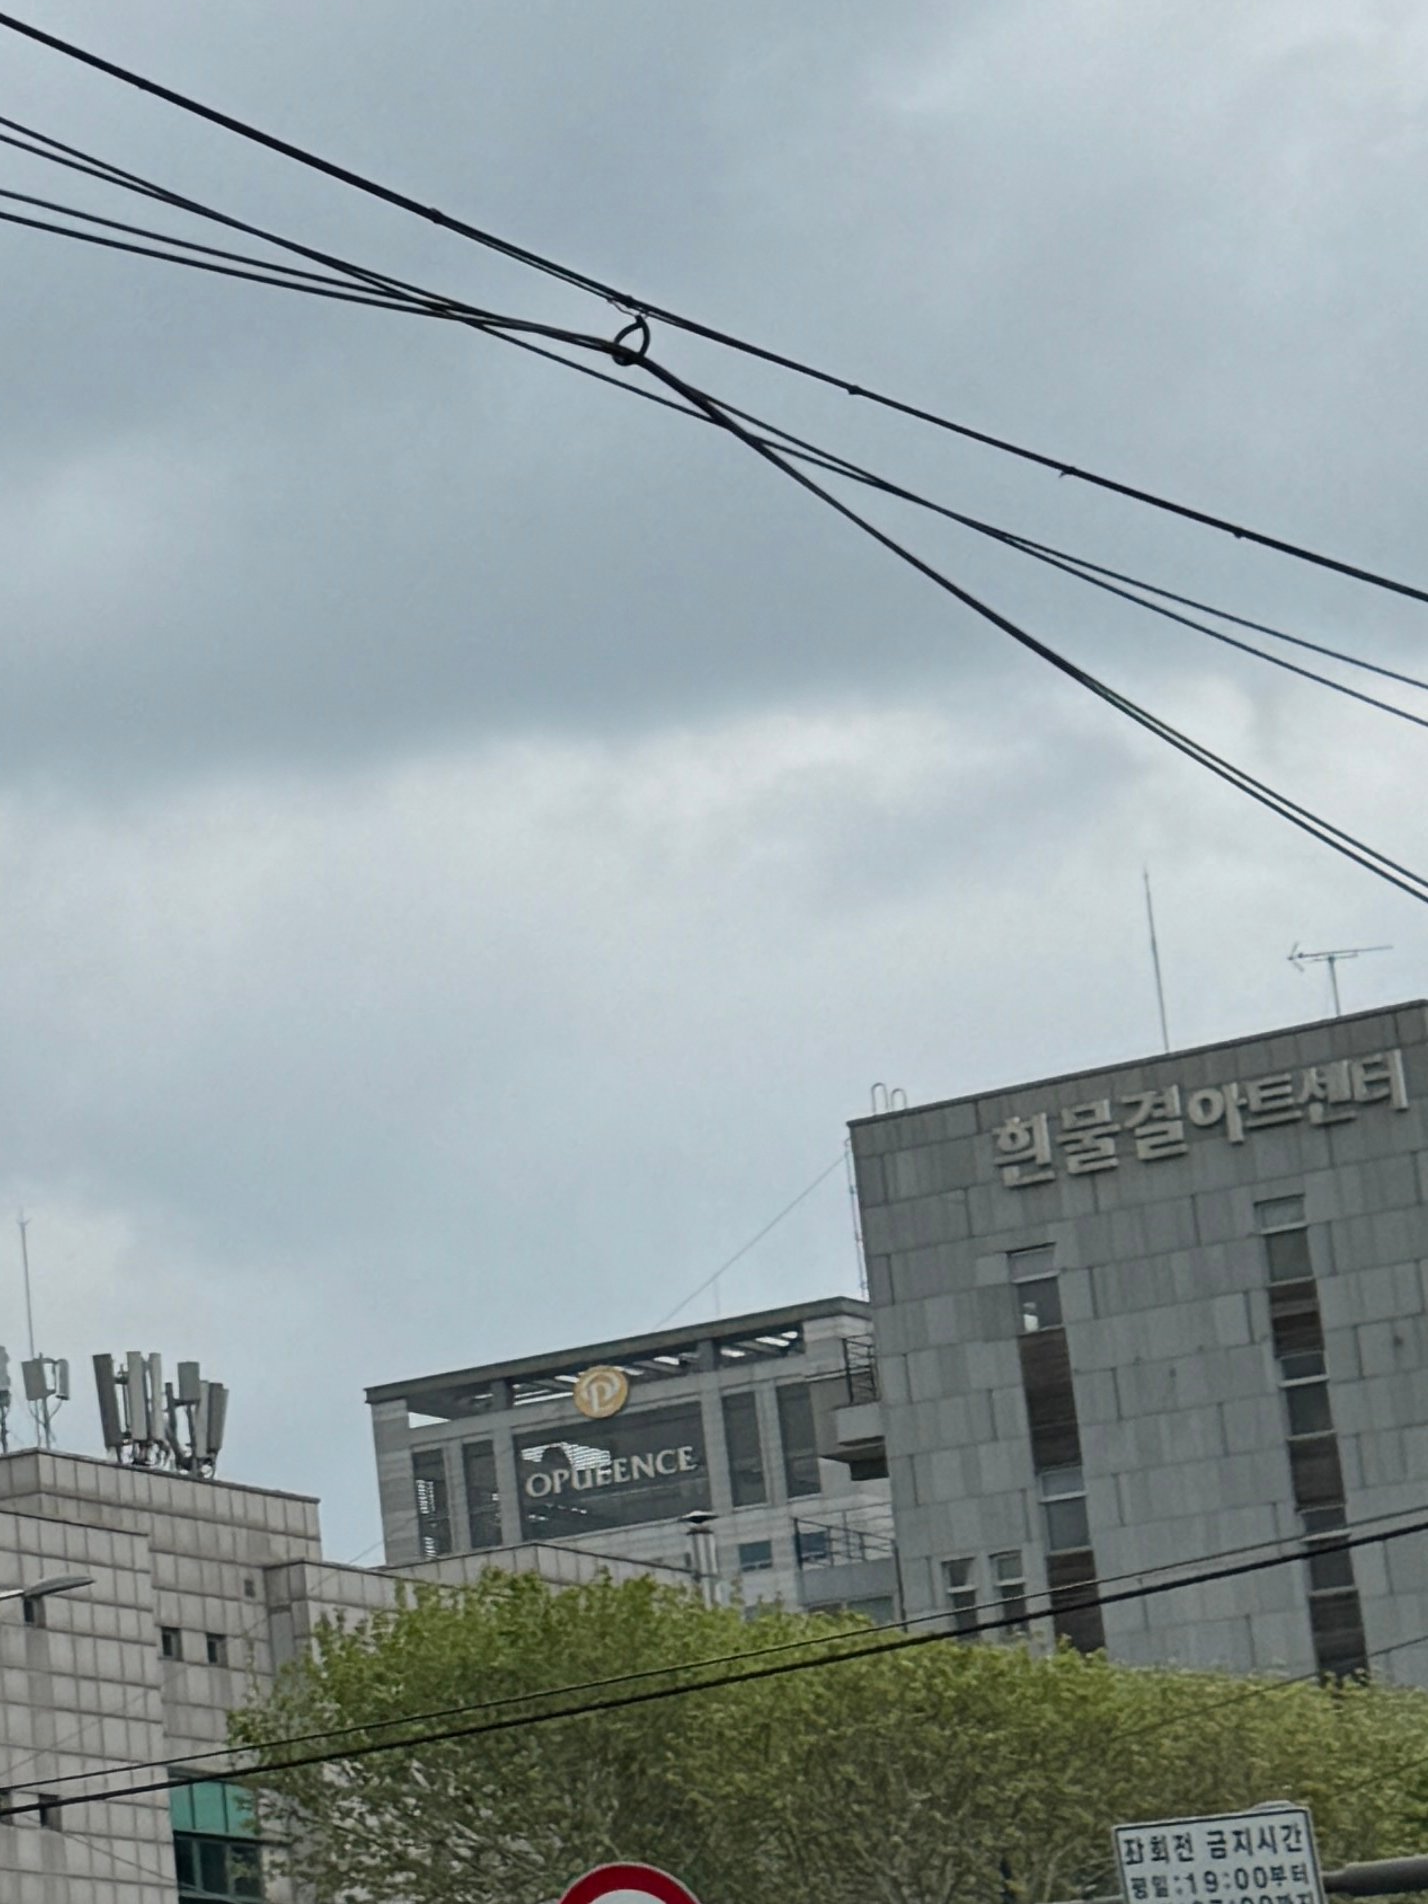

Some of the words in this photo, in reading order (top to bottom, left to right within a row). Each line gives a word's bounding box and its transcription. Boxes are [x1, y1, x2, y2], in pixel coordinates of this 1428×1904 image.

[992, 1049, 1409, 1187] 흰물결아트센터
[525, 1446, 697, 1497] OPULENCE
[1123, 1831, 1194, 1865] 좌회전
[1206, 1822, 1303, 1859] 금지시간
